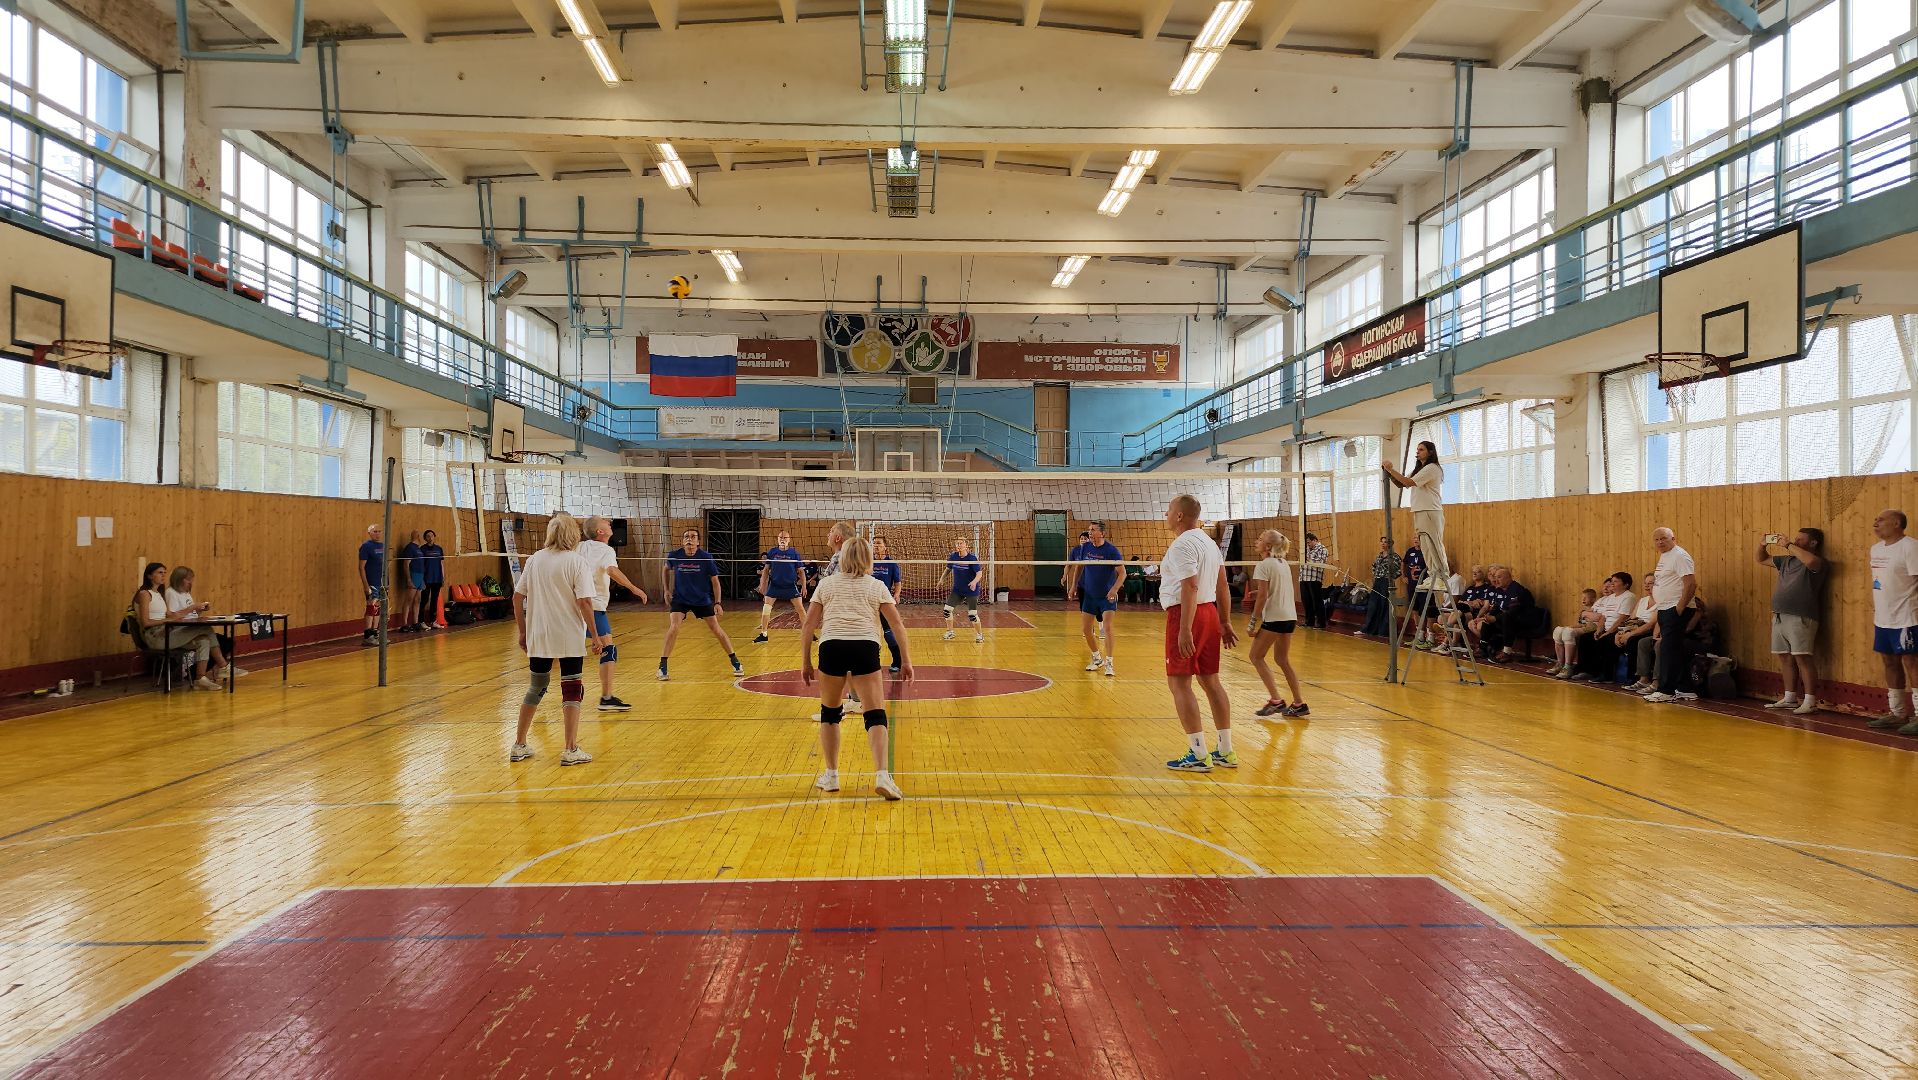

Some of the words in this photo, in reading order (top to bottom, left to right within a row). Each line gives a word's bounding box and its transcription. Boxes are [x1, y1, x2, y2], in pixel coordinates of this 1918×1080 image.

[1361, 313, 1405, 347] НОГИНСКАЯ
[1023, 354, 1100, 364] ИСТОЧНИК
[1104, 356, 1147, 364] СИЛЫ
[1351, 340, 1392, 370] ФЕДЕРАЦИЯ
[1392, 329, 1418, 354] БОКСА
[1052, 363, 1063, 371] И
